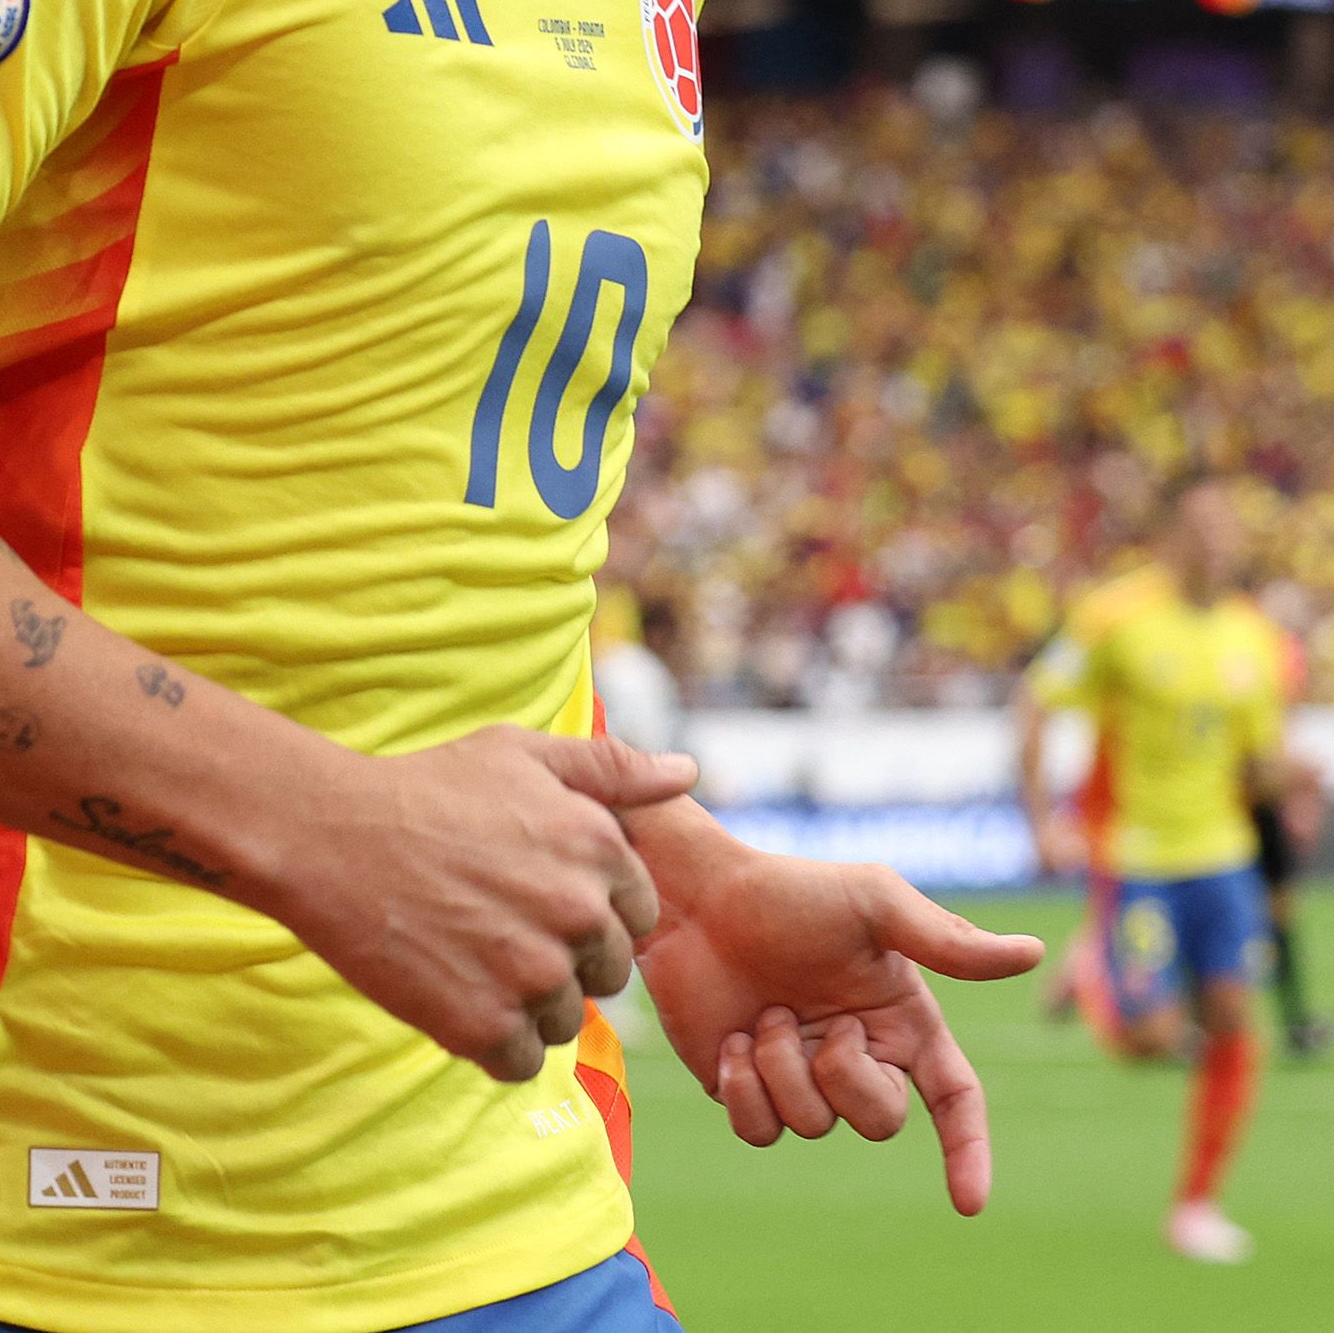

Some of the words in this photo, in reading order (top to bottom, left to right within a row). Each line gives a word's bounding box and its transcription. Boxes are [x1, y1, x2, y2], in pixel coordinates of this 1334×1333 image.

[538, 19, 571, 35] COLOMBIA
[578, 20, 605, 38] PANAMA
[464, 219, 648, 520] 10
[104, 1159, 147, 1171] AUTHENTIC
[110, 1175, 146, 1185] LICENSED
[110, 1189, 146, 1200] PRODUCT
